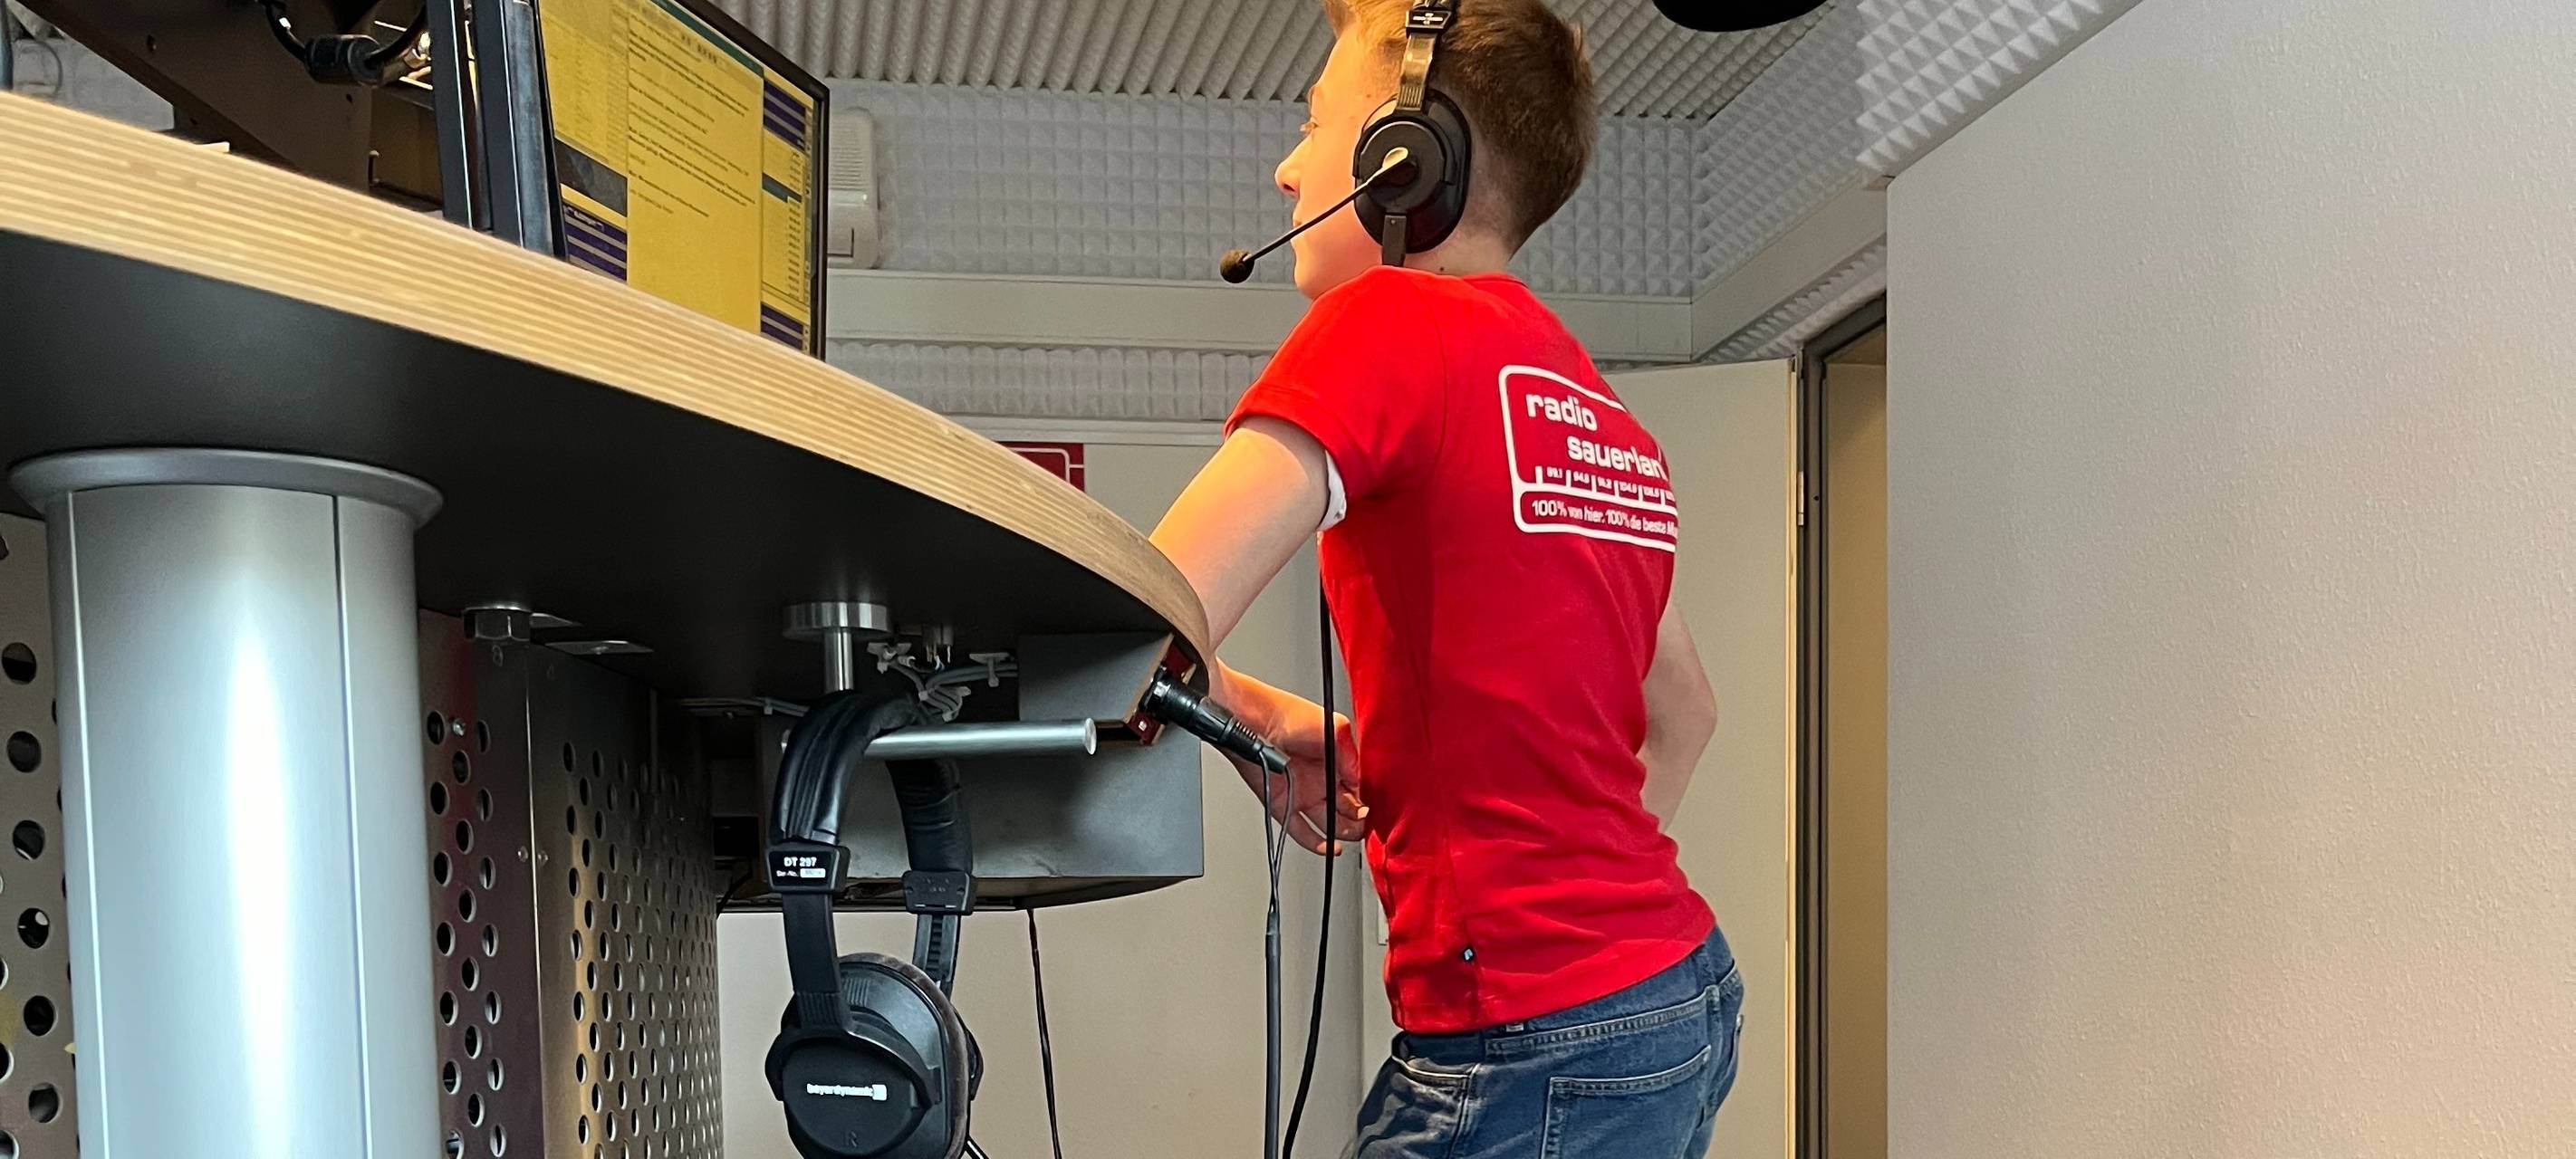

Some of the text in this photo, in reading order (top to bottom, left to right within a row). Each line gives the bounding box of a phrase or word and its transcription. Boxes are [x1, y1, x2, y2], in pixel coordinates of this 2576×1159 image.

[1526, 394, 1598, 432] radio
[1567, 436, 1668, 482] sauerlan
[1532, 500, 1567, 517] 100%
[1567, 506, 1583, 519] von
[1605, 509, 1629, 528] 100%
[783, 857, 798, 867] DT
